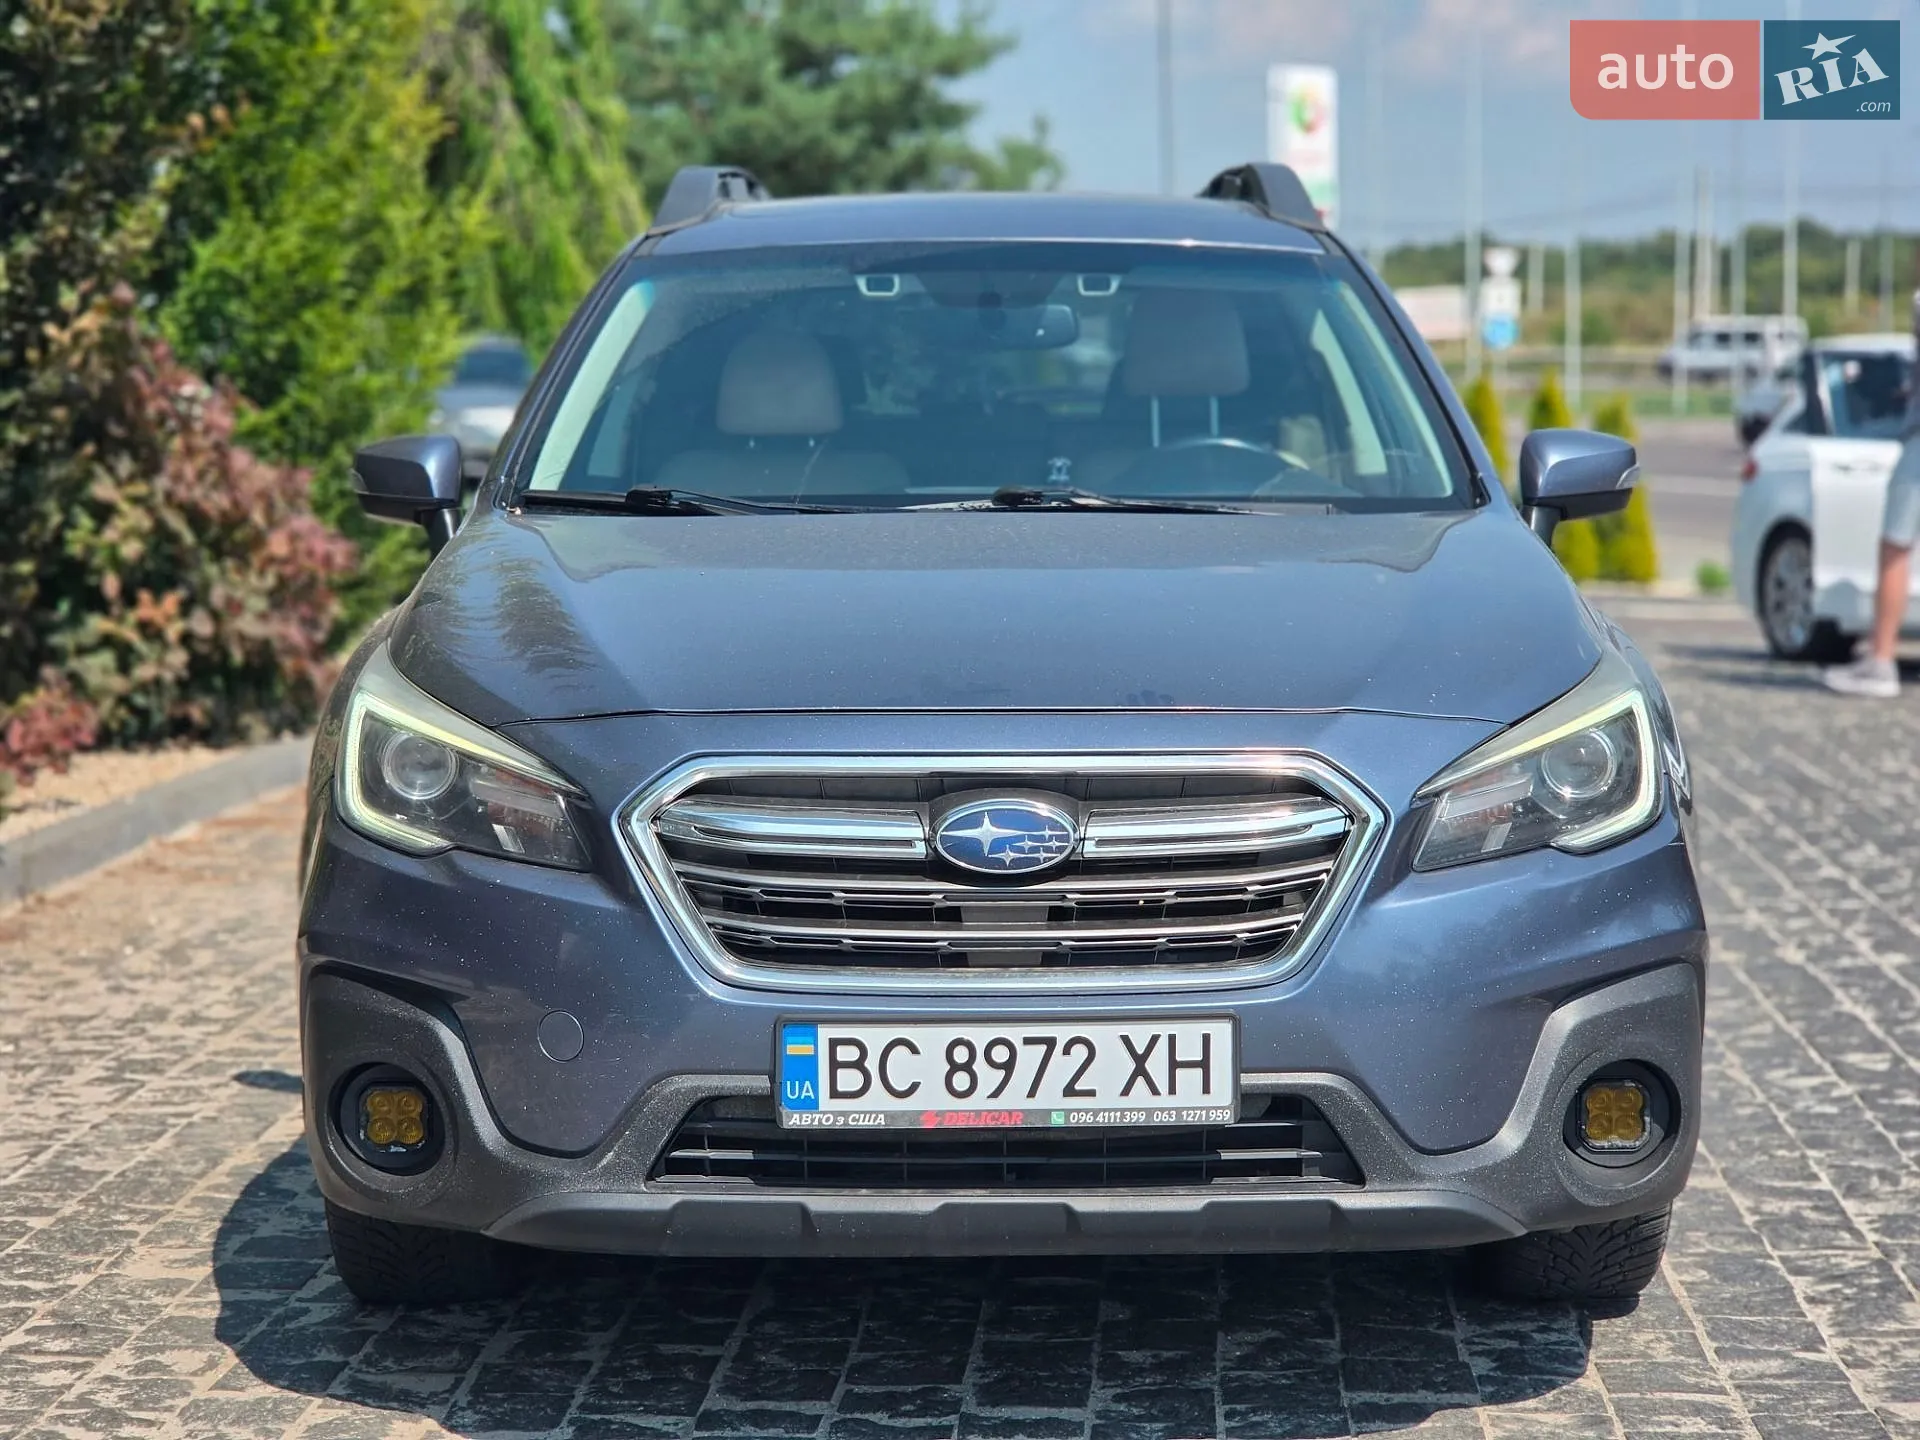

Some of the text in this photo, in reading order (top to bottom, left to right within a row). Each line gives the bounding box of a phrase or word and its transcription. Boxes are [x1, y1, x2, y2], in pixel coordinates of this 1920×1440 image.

[828, 1033, 1211, 1099] BC 8972 XH
[786, 1081, 815, 1099] UA
[788, 1113, 835, 1126] АВТО
[848, 1113, 886, 1126] США
[943, 1111, 1023, 1126] DELICAR
[1069, 1112, 1093, 1123] 096
[1124, 1111, 1146, 1123] 399
[1153, 1110, 1176, 1122] 063
[1181, 1110, 1206, 1122] 1271
[1209, 1109, 1231, 1121] 959
